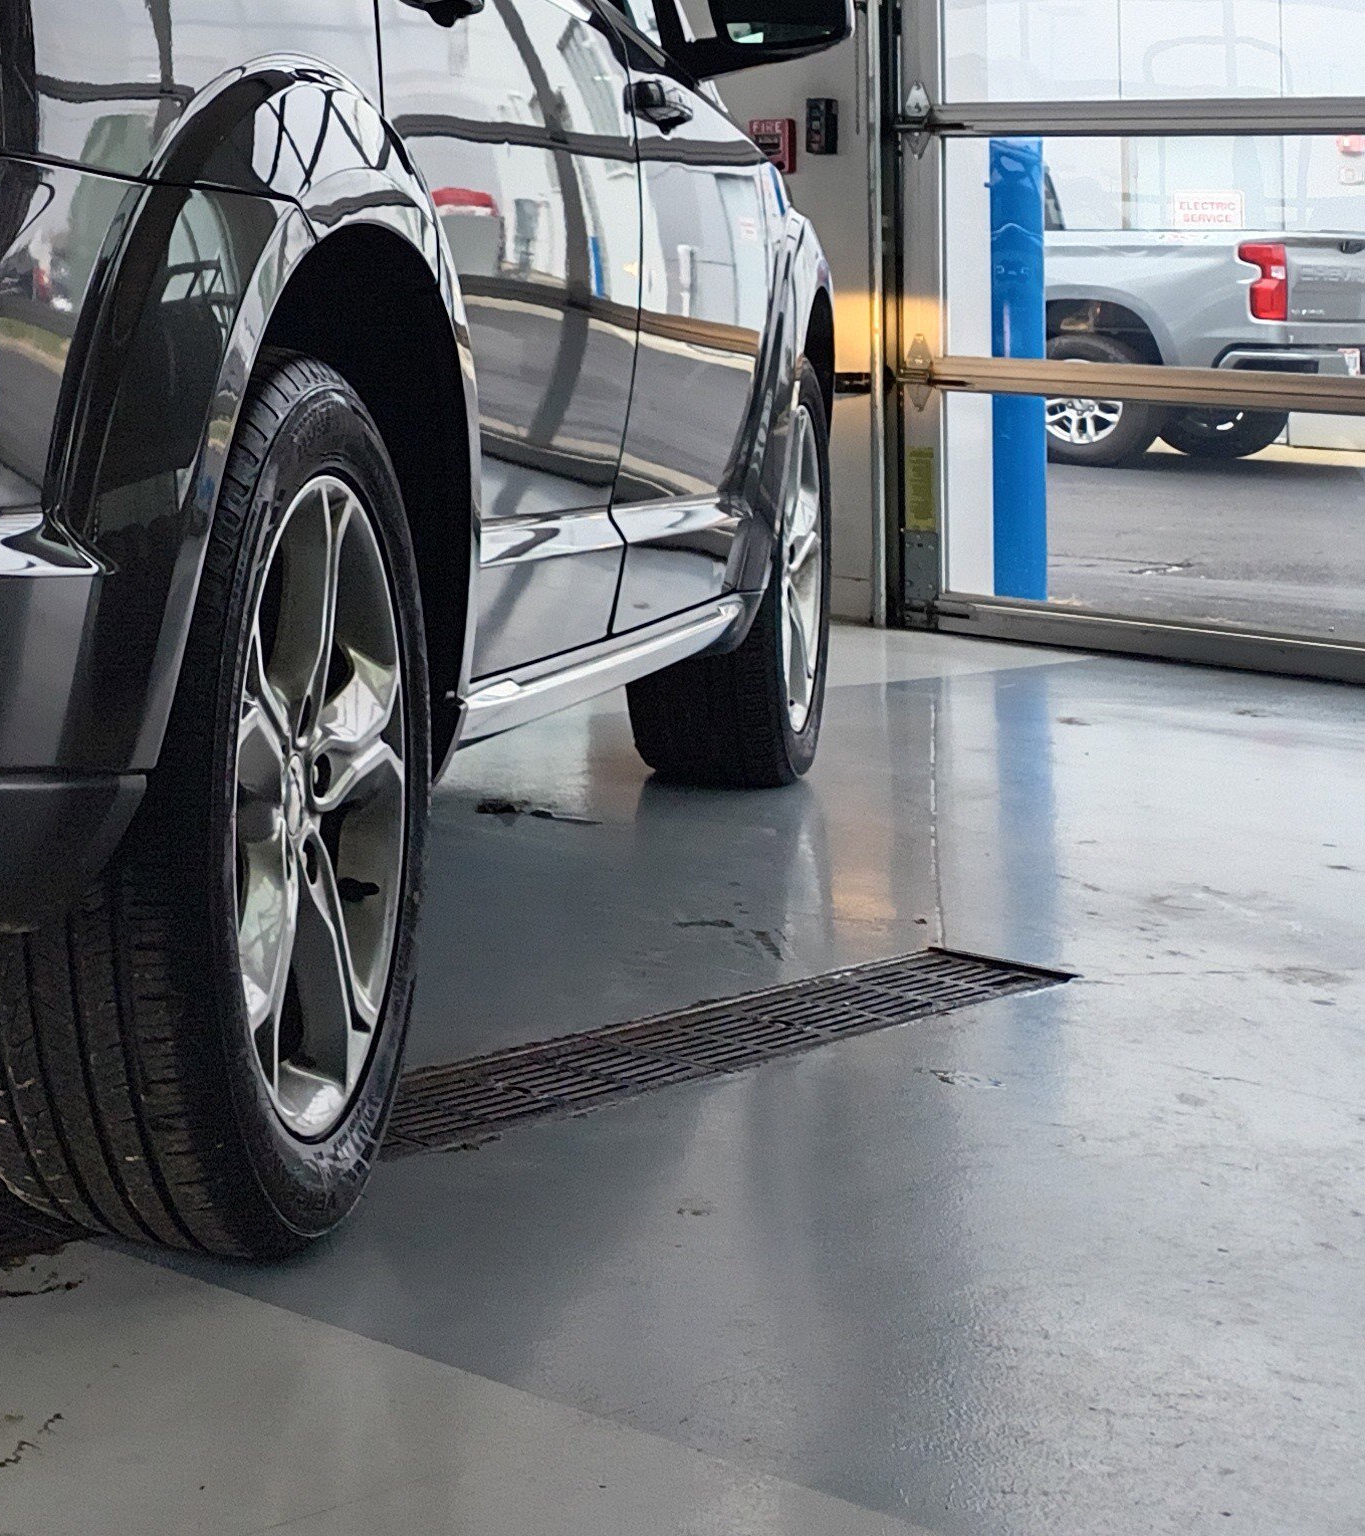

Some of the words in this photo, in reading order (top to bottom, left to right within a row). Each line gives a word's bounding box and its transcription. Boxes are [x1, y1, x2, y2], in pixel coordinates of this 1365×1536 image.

[752, 121, 782, 133] FIRE
[1178, 201, 1236, 211] ELECTRIC
[1183, 213, 1233, 223] SERVICE
